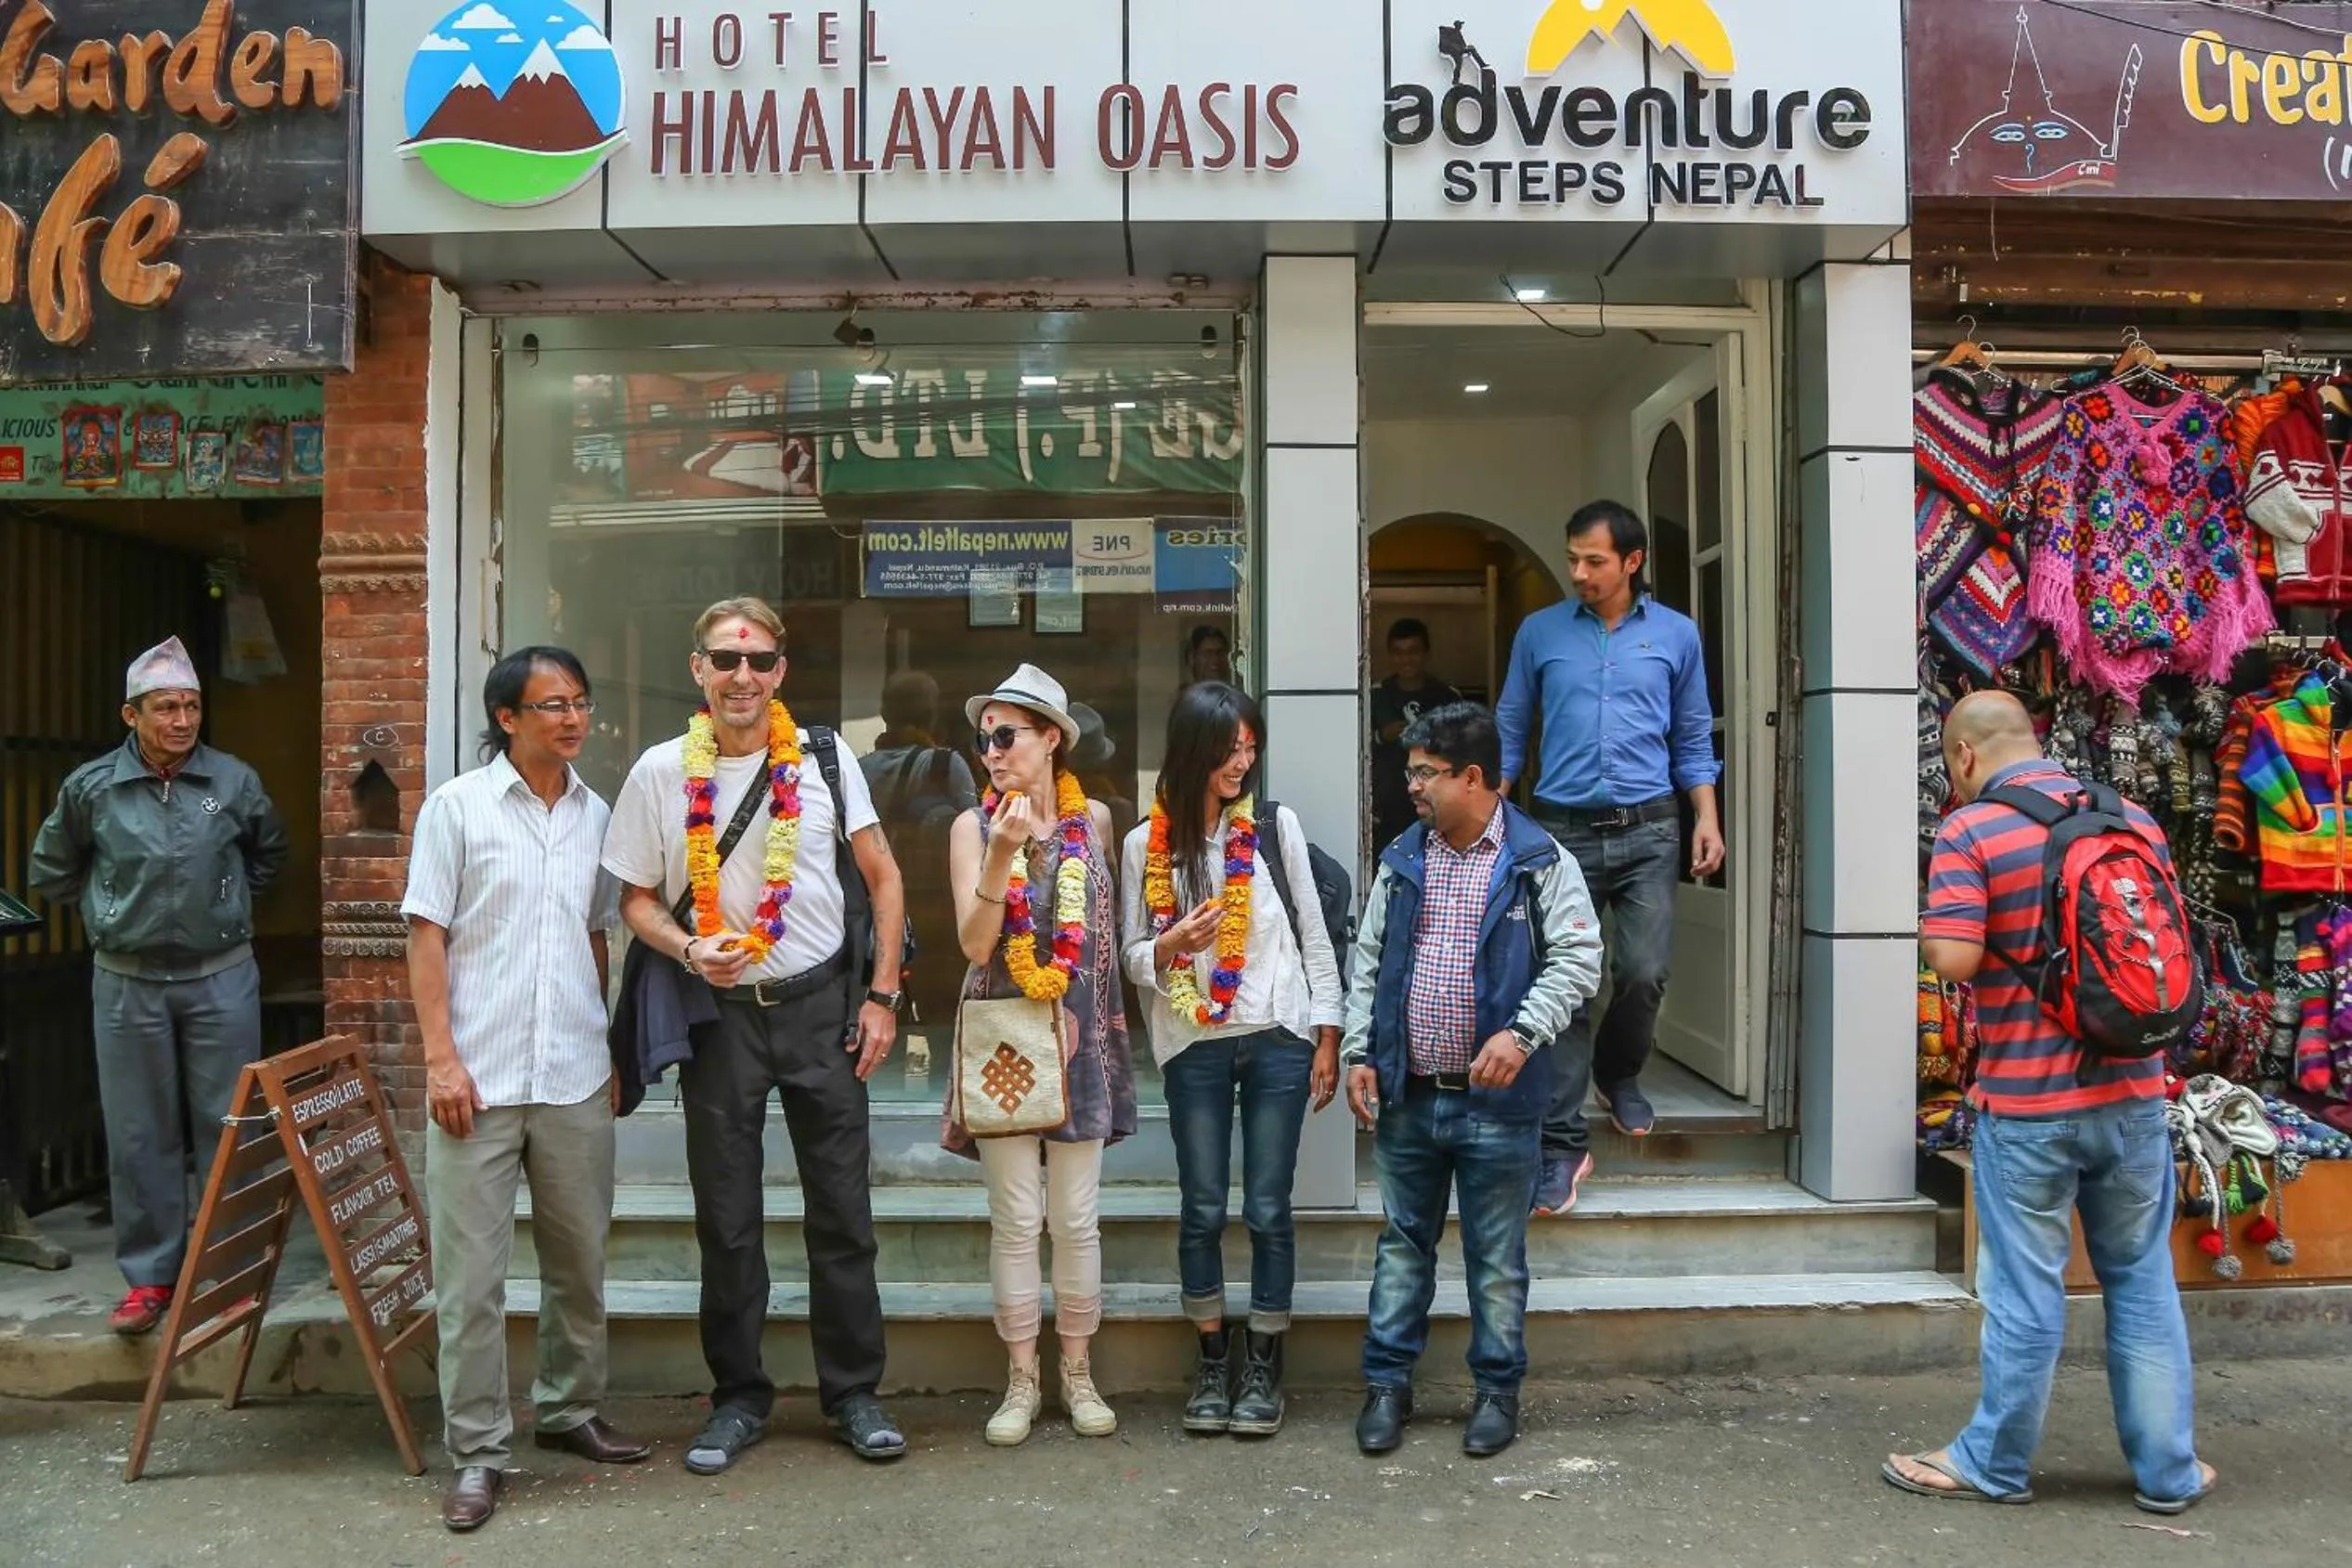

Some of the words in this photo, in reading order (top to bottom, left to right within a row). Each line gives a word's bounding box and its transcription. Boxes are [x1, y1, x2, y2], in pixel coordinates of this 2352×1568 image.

[655, 10, 890, 71] HOTEL
[650, 85, 1056, 176] HIMALAYAN
[1098, 83, 1300, 172] OASIS
[1384, 69, 1872, 150] adventure
[1442, 159, 1626, 205] STEPS
[1650, 162, 1826, 208] NEPAL
[0, 418, 57, 438] ICIOUS
[314, 1145, 344, 1174] COLD
[345, 1125, 383, 1156] COFFEE
[330, 1185, 376, 1225] FLAVOUR
[374, 1173, 399, 1197] TEA
